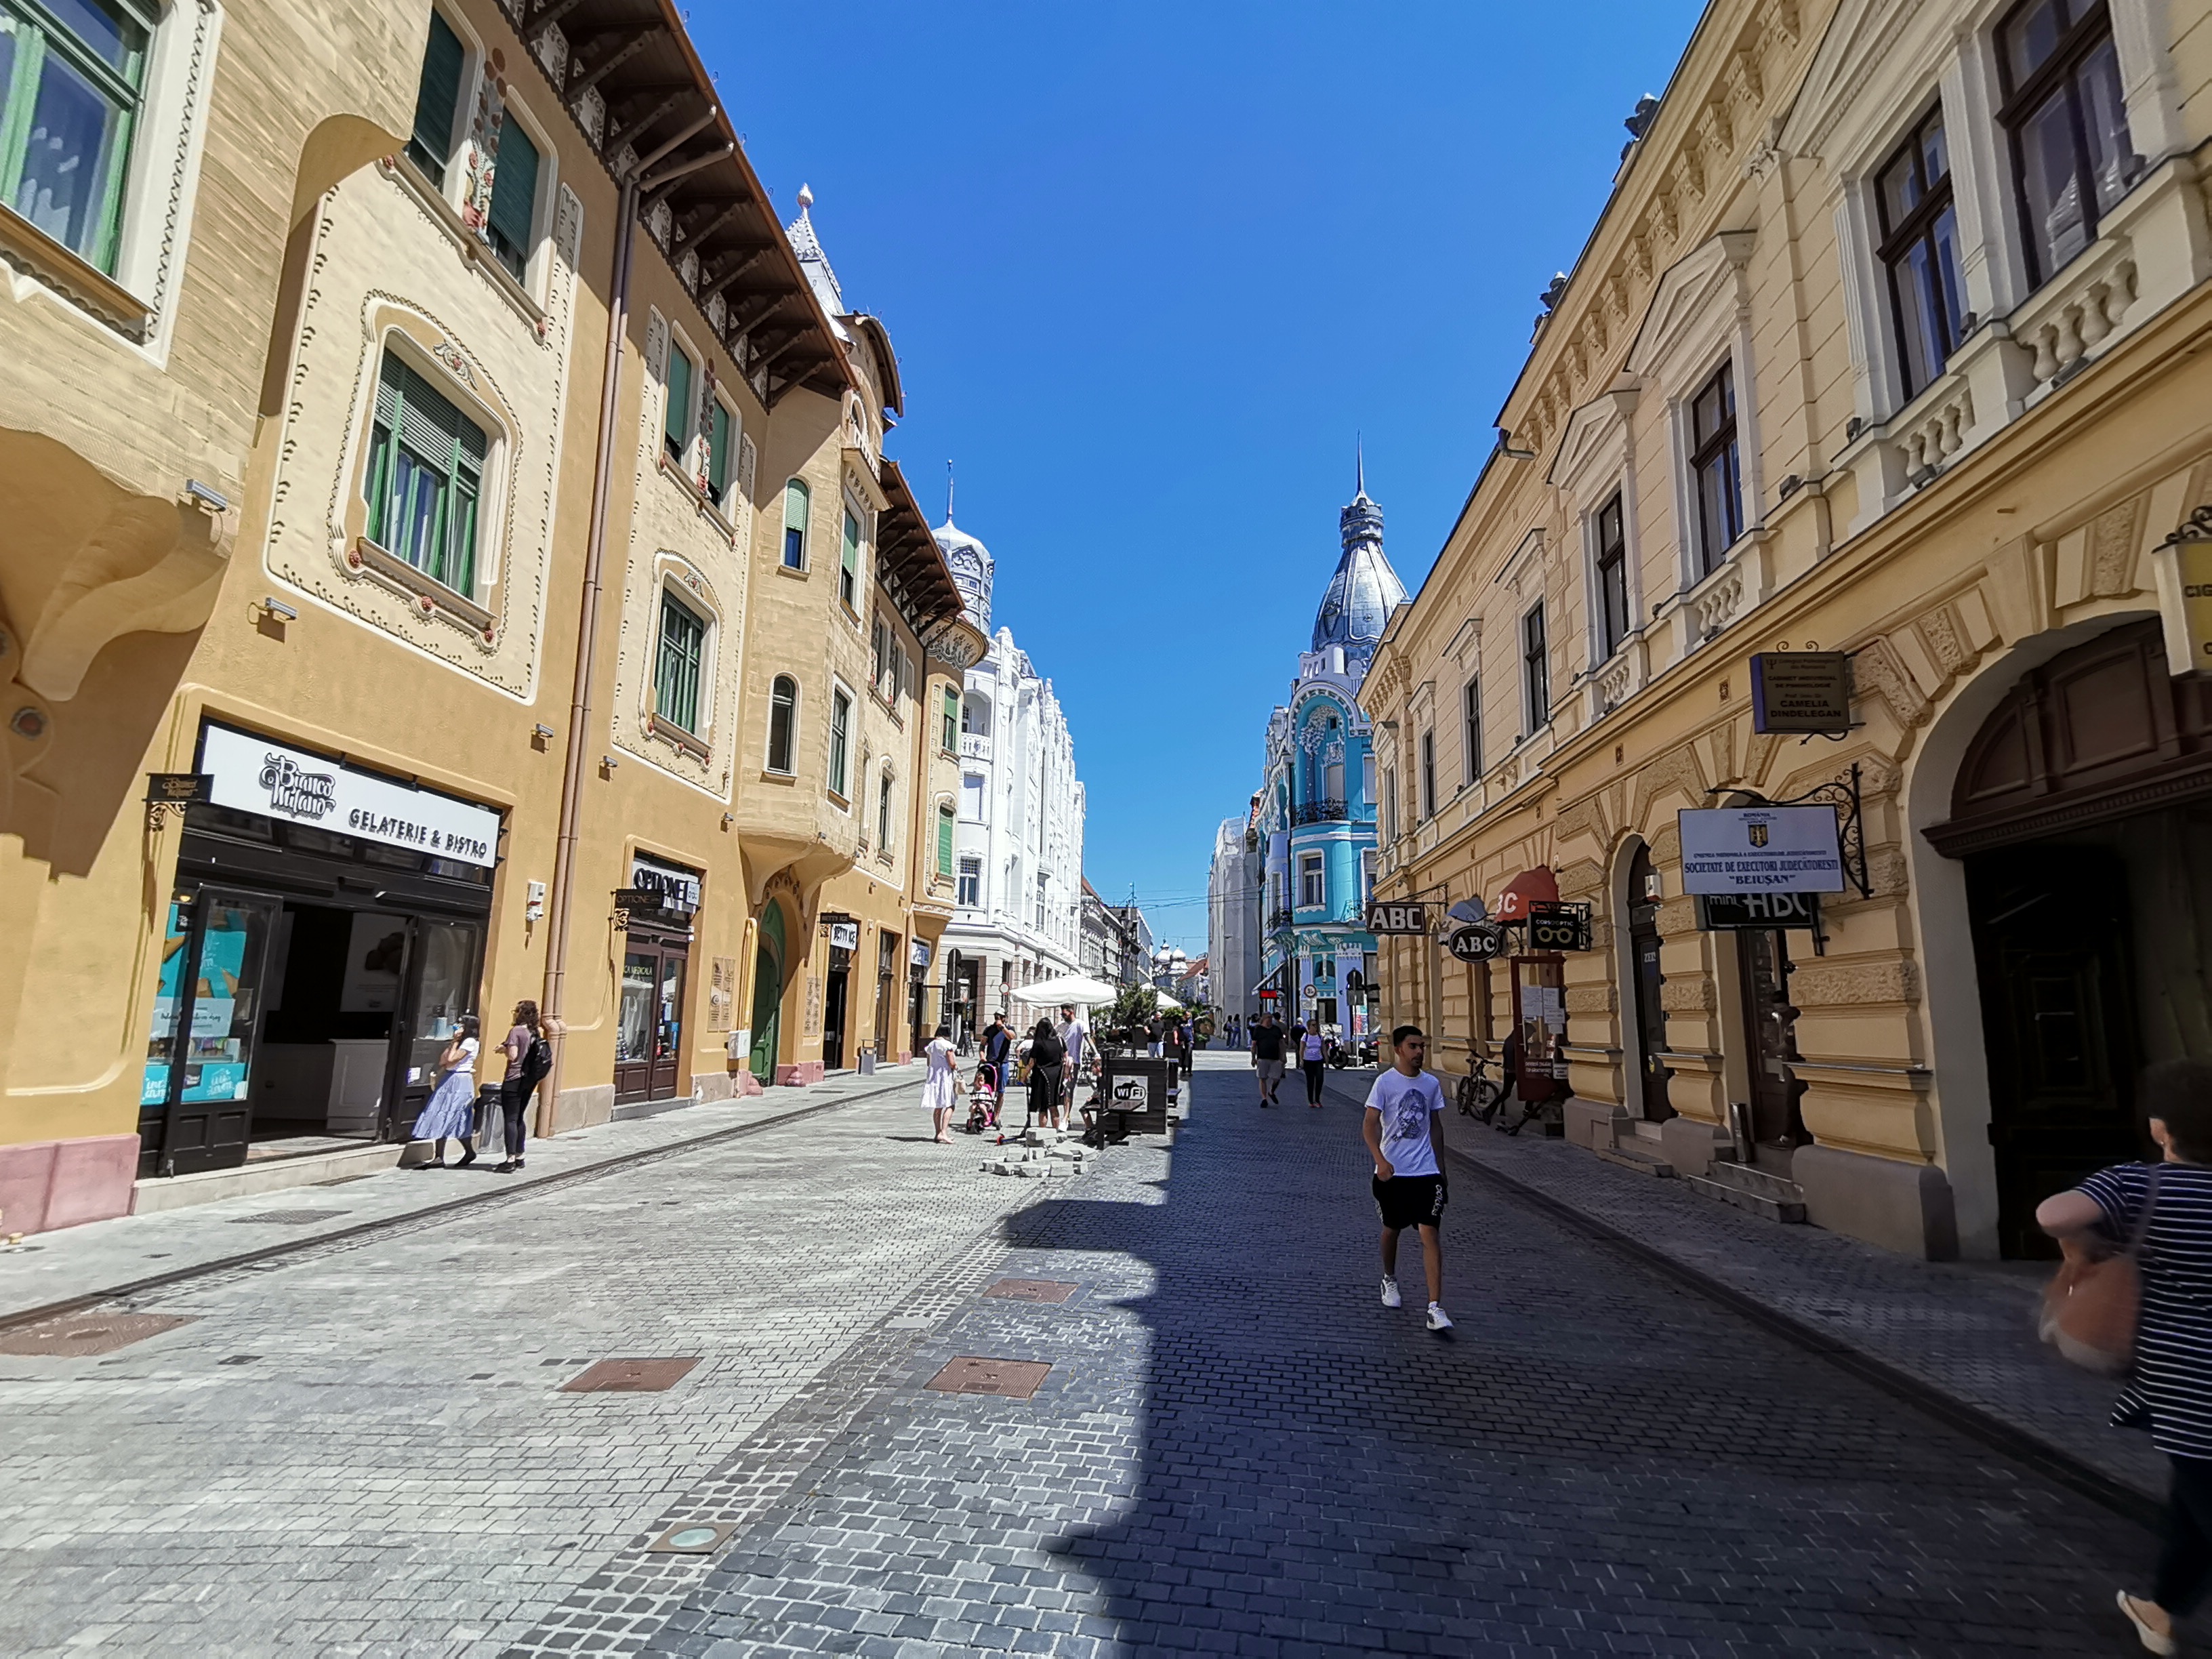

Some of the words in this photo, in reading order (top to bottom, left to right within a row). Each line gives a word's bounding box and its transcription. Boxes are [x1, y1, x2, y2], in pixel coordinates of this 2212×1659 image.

[264, 752, 335, 798] Bianco
[260, 766, 337, 815] Milano
[349, 808, 427, 842] GELATERIE
[431, 830, 441, 846] &
[445, 833, 487, 857] BISTRO
[1685, 861, 1723, 873] SOCIETATE
[1725, 861, 1734, 872] DE
[1737, 861, 1778, 872] EXECUTORI
[616, 895, 649, 903] OPTIONE
[1369, 907, 1422, 930] ABC
[834, 925, 848, 942] BETTY
[1456, 936, 1496, 953] ABC
